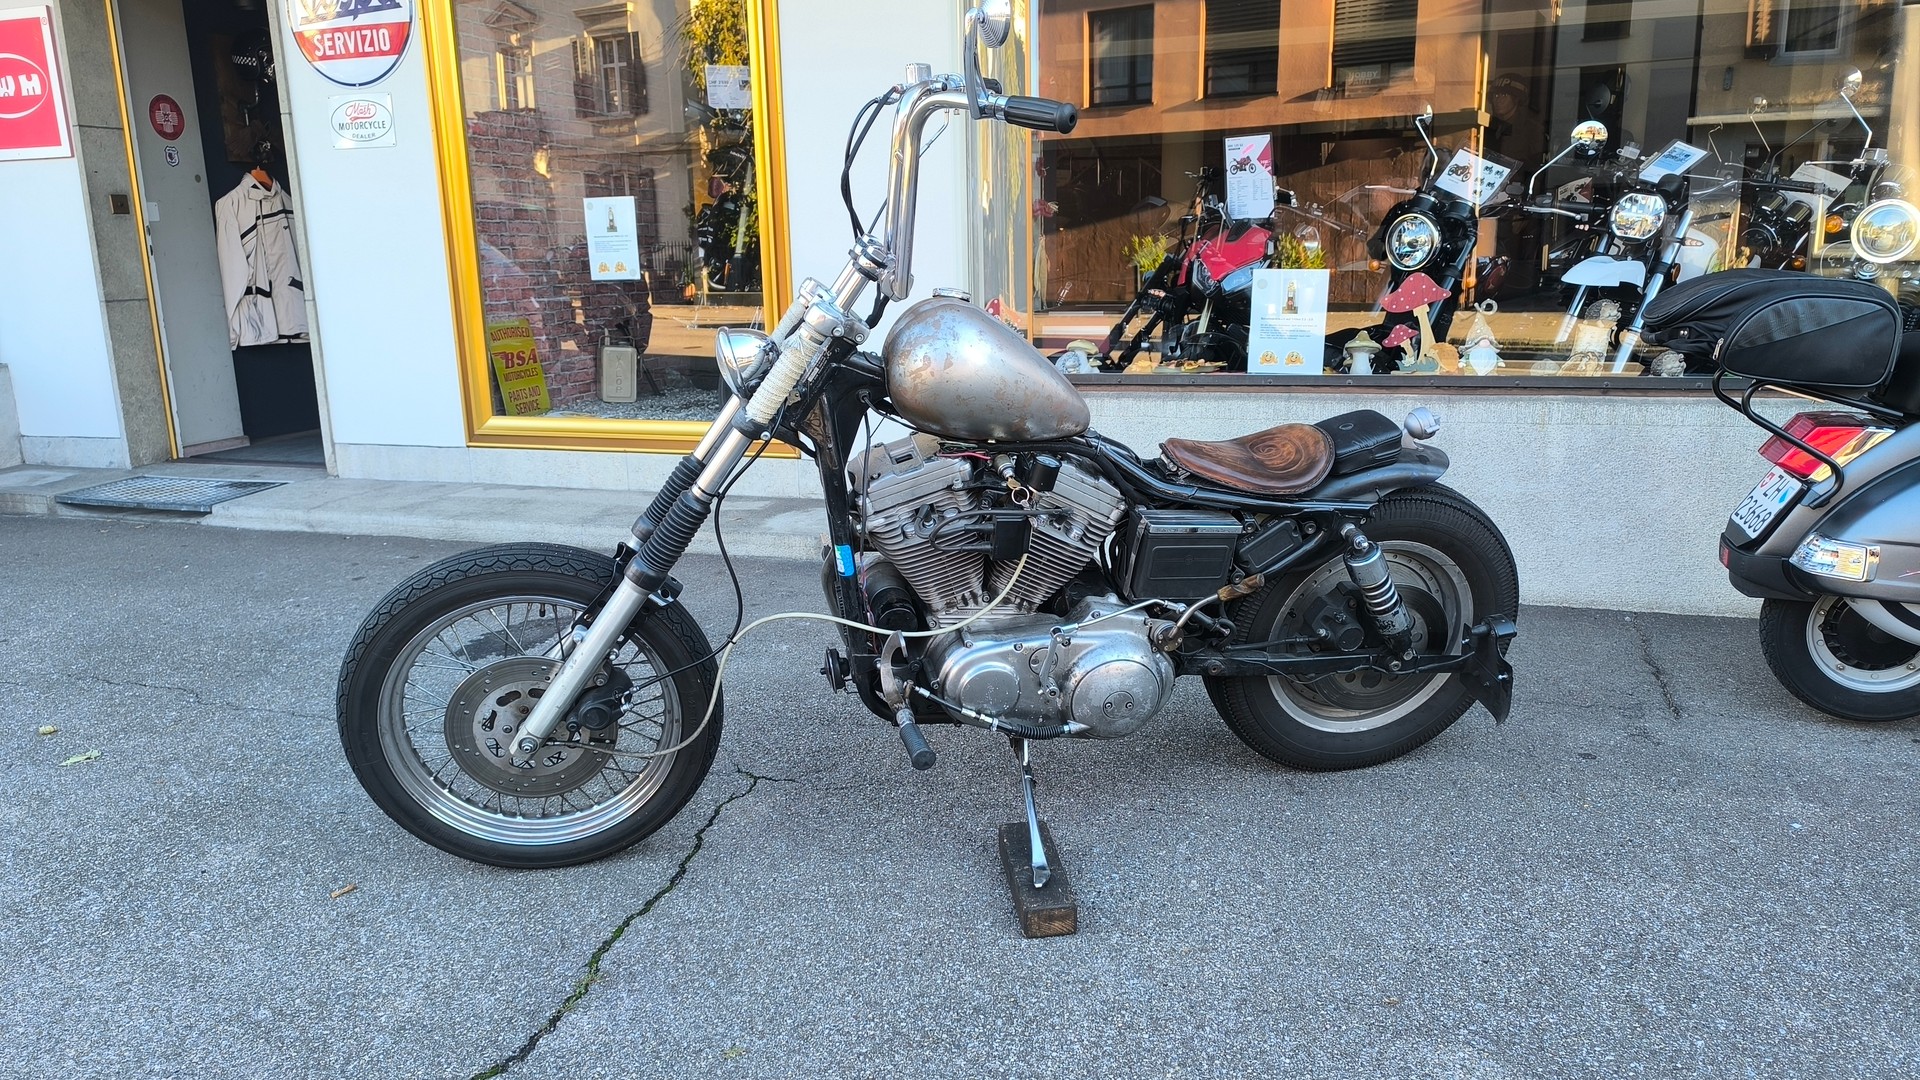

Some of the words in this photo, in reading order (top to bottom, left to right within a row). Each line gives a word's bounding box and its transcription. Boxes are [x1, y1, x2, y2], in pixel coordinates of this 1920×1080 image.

[313, 28, 391, 57] SERVIZIO
[338, 120, 387, 131] MOTORCYCLE
[351, 132, 377, 140] DEALER
[490, 326, 530, 343] AUTHORISED
[500, 348, 538, 370] BSA
[503, 367, 539, 383] MOTORCYCLES
[508, 388, 529, 402] PARTS
[529, 385, 541, 398] AND
[515, 398, 541, 415] SERVICE
[1763, 474, 1790, 502] ZH
[1734, 495, 1772, 533] 23668
